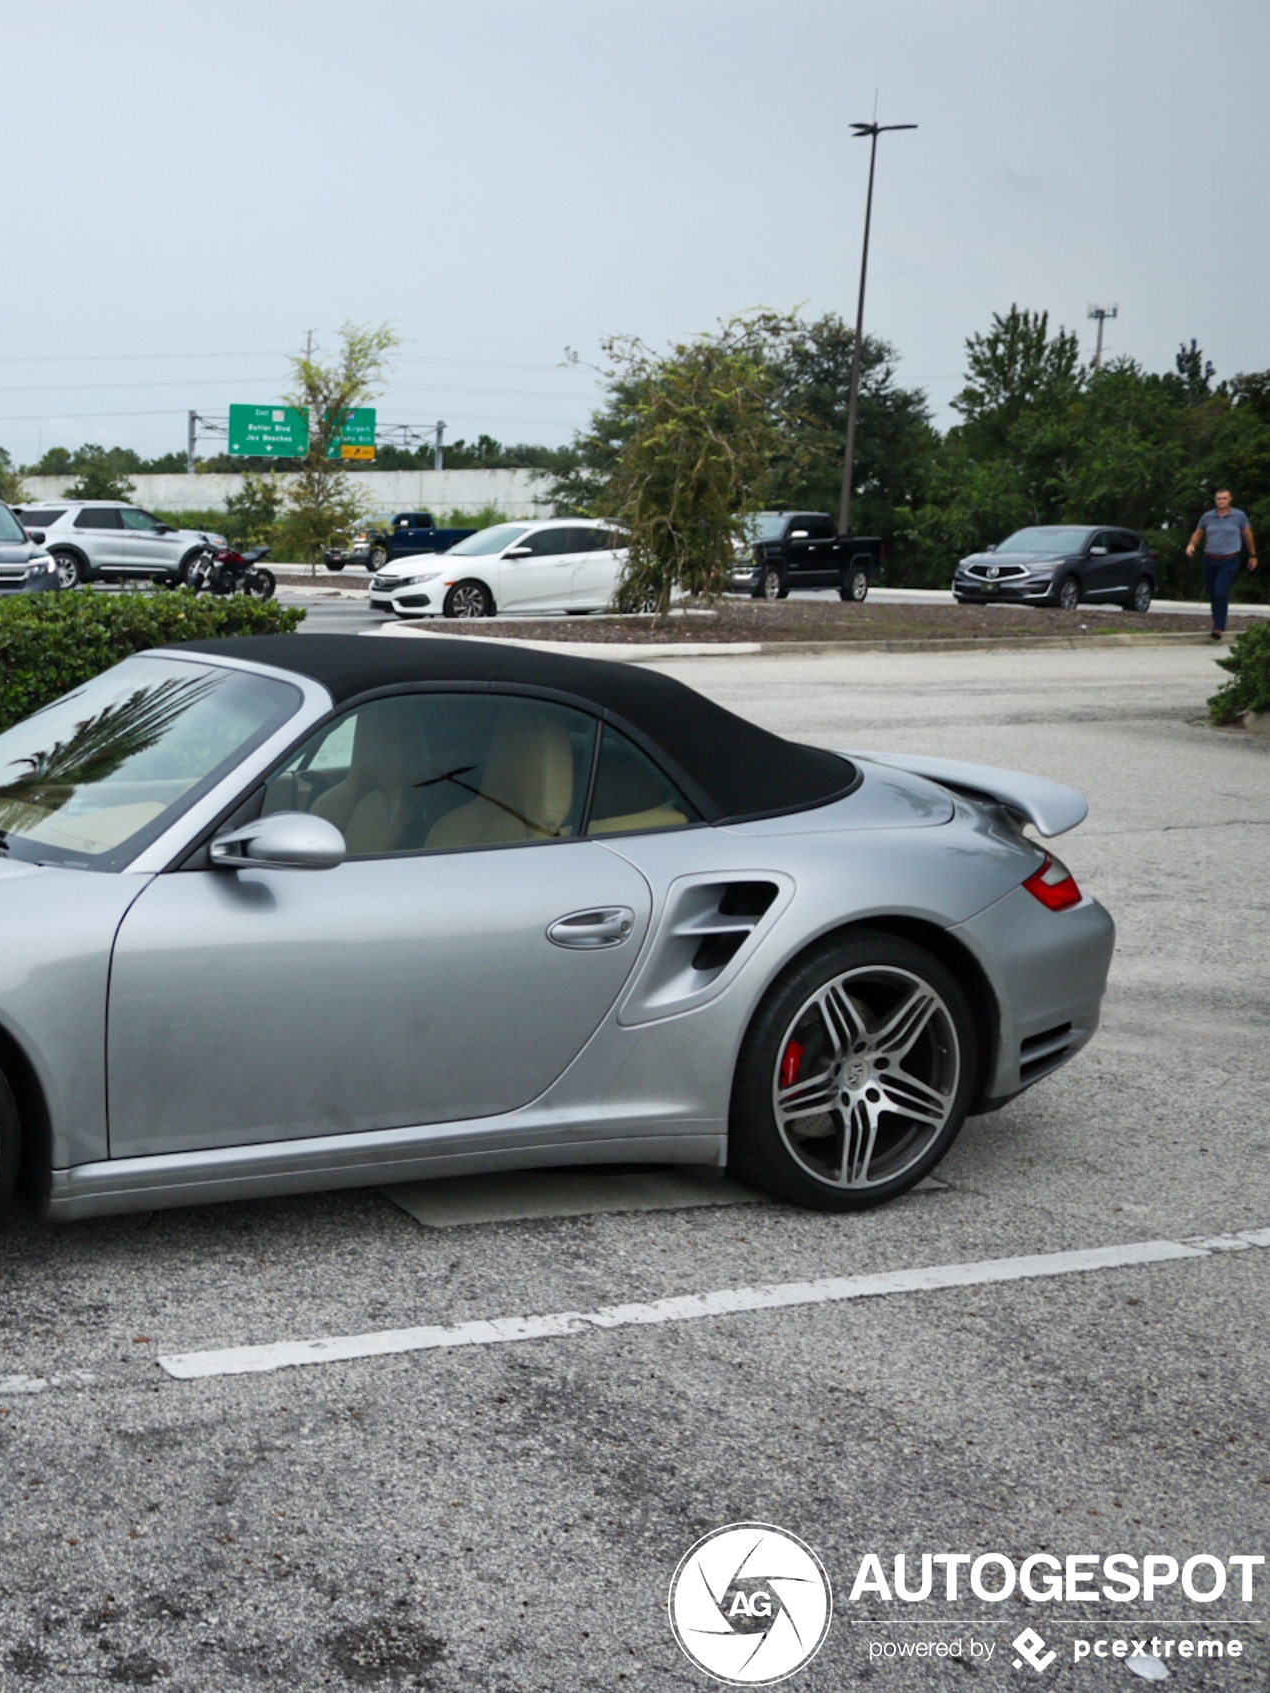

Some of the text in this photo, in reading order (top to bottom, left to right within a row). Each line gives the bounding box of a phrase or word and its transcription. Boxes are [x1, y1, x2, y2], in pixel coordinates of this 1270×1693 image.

[248, 424, 291, 433] Butler Blvd
[345, 425, 371, 433] Airport
[262, 435, 293, 443] Beaches
